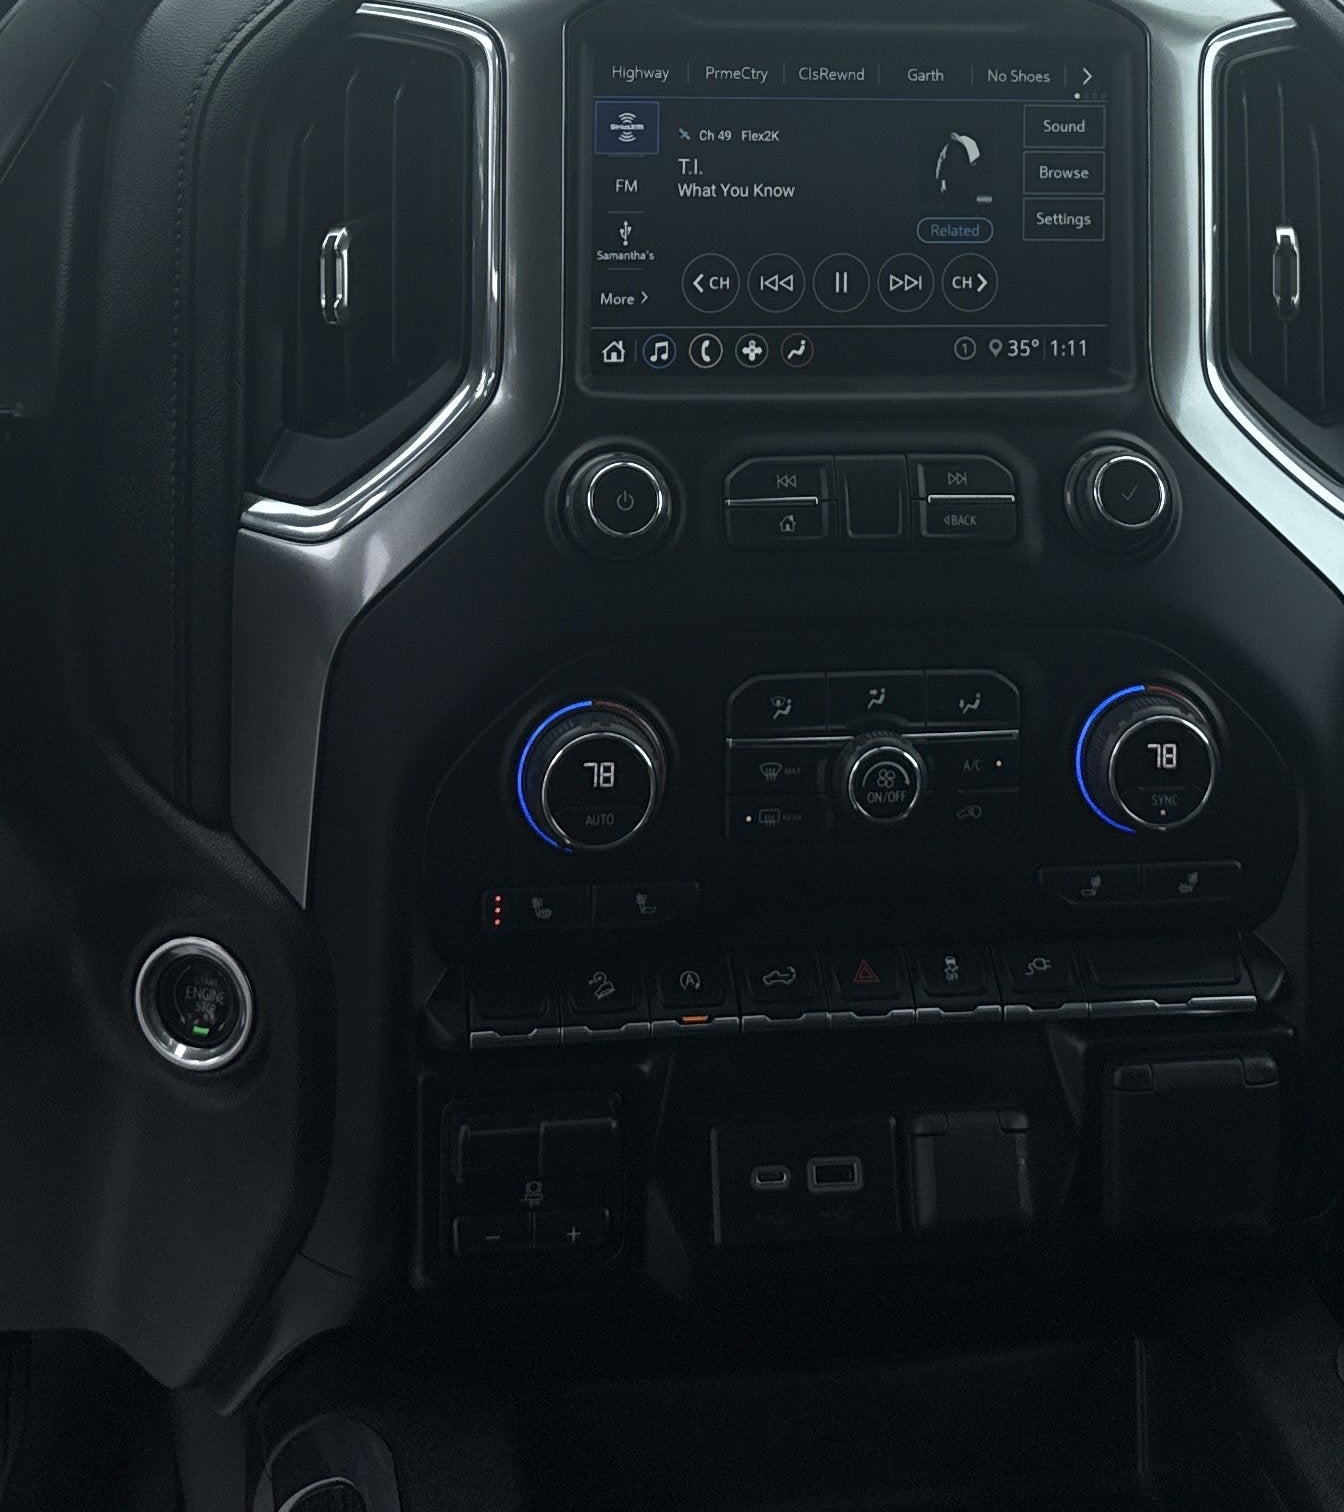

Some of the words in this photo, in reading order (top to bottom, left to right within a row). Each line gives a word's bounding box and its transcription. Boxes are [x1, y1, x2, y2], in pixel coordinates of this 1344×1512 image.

[611, 65, 670, 83] Highway
[705, 66, 769, 84] PrmeCtry
[798, 67, 865, 82] ClsRewnd
[907, 68, 944, 82] Garth
[987, 69, 1007, 83] No
[1010, 69, 1051, 83] Shoes
[1042, 119, 1086, 133] Sound
[698, 129, 715, 142] Ch
[718, 129, 733, 142] 49
[741, 129, 780, 142] Flex2K
[1039, 166, 1090, 179] Browse
[615, 179, 638, 193] FM
[677, 183, 717, 198] What
[720, 183, 749, 198] You
[753, 183, 796, 198] Know
[1036, 211, 1092, 230] Settings
[930, 223, 980, 237] Related
[596, 249, 655, 262] Samantha's
[708, 276, 730, 290] CH
[951, 275, 973, 289] CH
[599, 292, 635, 306] More
[1050, 338, 1087, 357] 1:11
[951, 513, 977, 526] BACK
[1147, 743, 1177, 768] 78
[962, 758, 982, 772] A/C
[583, 761, 615, 788] 78
[866, 791, 907, 805] ON/OFF
[1151, 793, 1178, 806] SYNC
[584, 812, 615, 826] AUTO
[186, 986, 226, 1005] ENGINE
